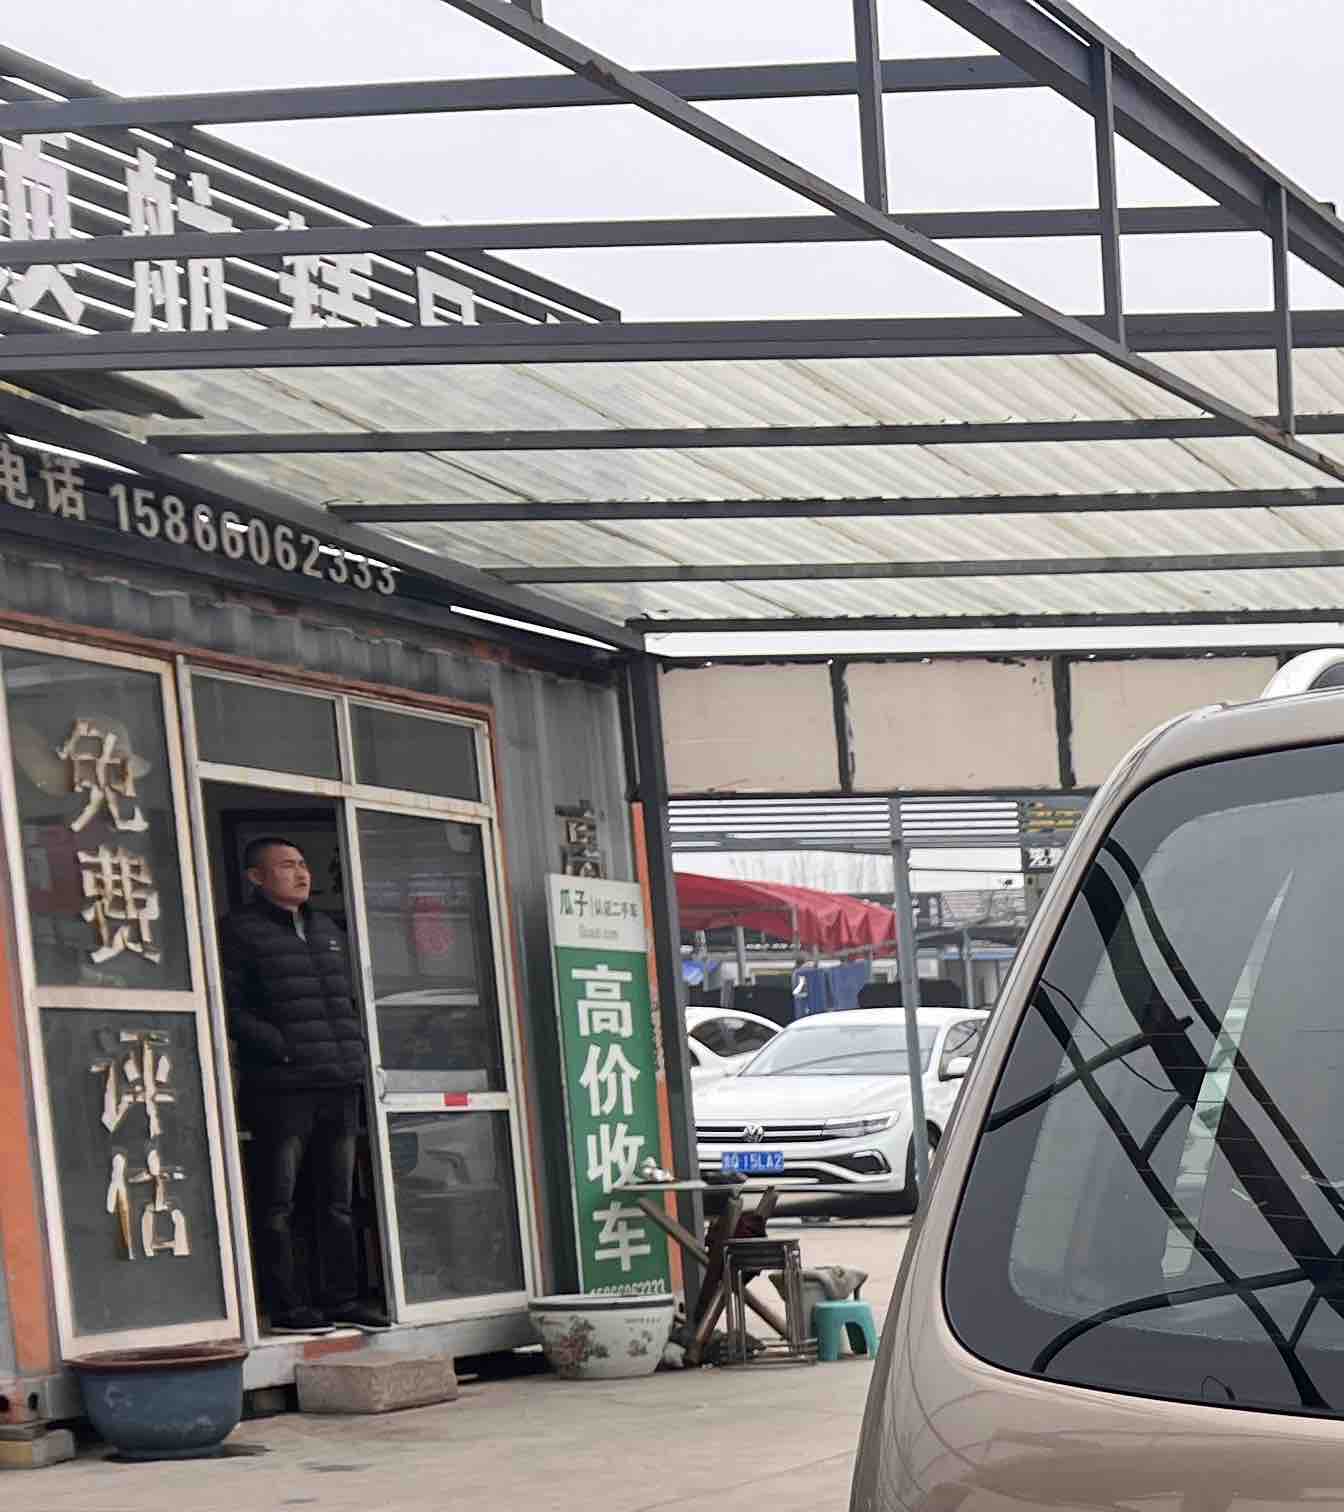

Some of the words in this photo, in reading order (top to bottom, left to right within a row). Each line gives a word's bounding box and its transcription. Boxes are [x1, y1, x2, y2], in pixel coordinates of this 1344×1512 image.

[0, 441, 86, 521] 电话
[109, 482, 399, 597] 15866062333
[57, 718, 150, 966] 免费
[90, 1029, 192, 1262] 评估
[570, 963, 652, 1273] 高价收车
